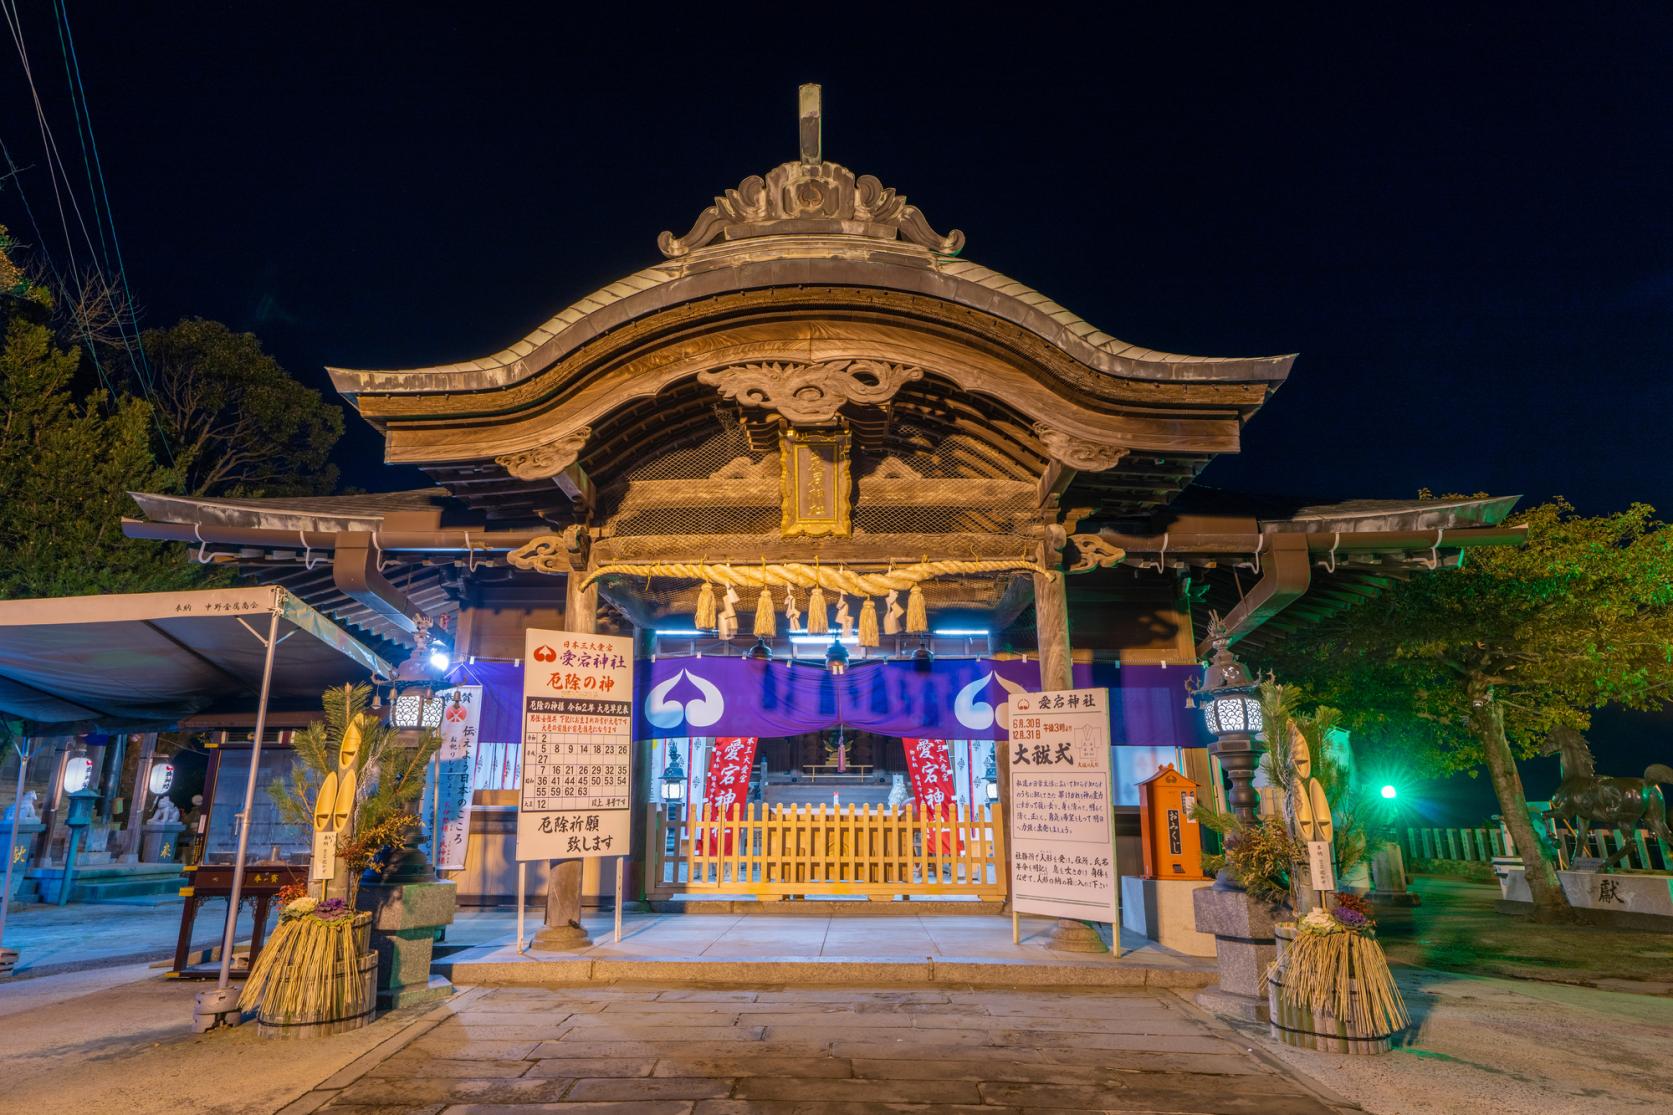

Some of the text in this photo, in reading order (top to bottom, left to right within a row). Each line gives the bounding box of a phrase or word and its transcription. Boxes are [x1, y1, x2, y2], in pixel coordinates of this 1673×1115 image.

[563, 641, 614, 651] 日本三大愛宕
[560, 650, 627, 670] 愛宕神社
[547, 672, 615, 692] 厄除の神
[530, 700, 565, 711] 厄除の神様
[567, 704, 595, 712] 令和2年
[1039, 694, 1096, 709] 愛宕神社
[542, 745, 546, 753] 5
[555, 745, 560, 753] 8
[569, 745, 573, 753] 9
[594, 745, 601, 753] 18
[618, 746, 627, 754] 26
[1013, 743, 1073, 765] 大祓式
[538, 755, 548, 763] 27
[541, 766, 627, 775] 7 16 21 26 29 32 35
[453, 726, 475, 844] 伝えよう日本のこころ
[537, 777, 547, 785] 36
[551, 777, 560, 785] 41
[565, 777, 575, 785] 44
[578, 777, 588, 785] 45
[591, 777, 600, 785] 50
[604, 777, 613, 785] 53
[537, 787, 587, 796] 55 59 62 63
[537, 800, 546, 809] 12
[538, 815, 600, 833] 厄除祈願
[1169, 811, 1180, 854] おみくじ
[567, 835, 614, 853] 致します
